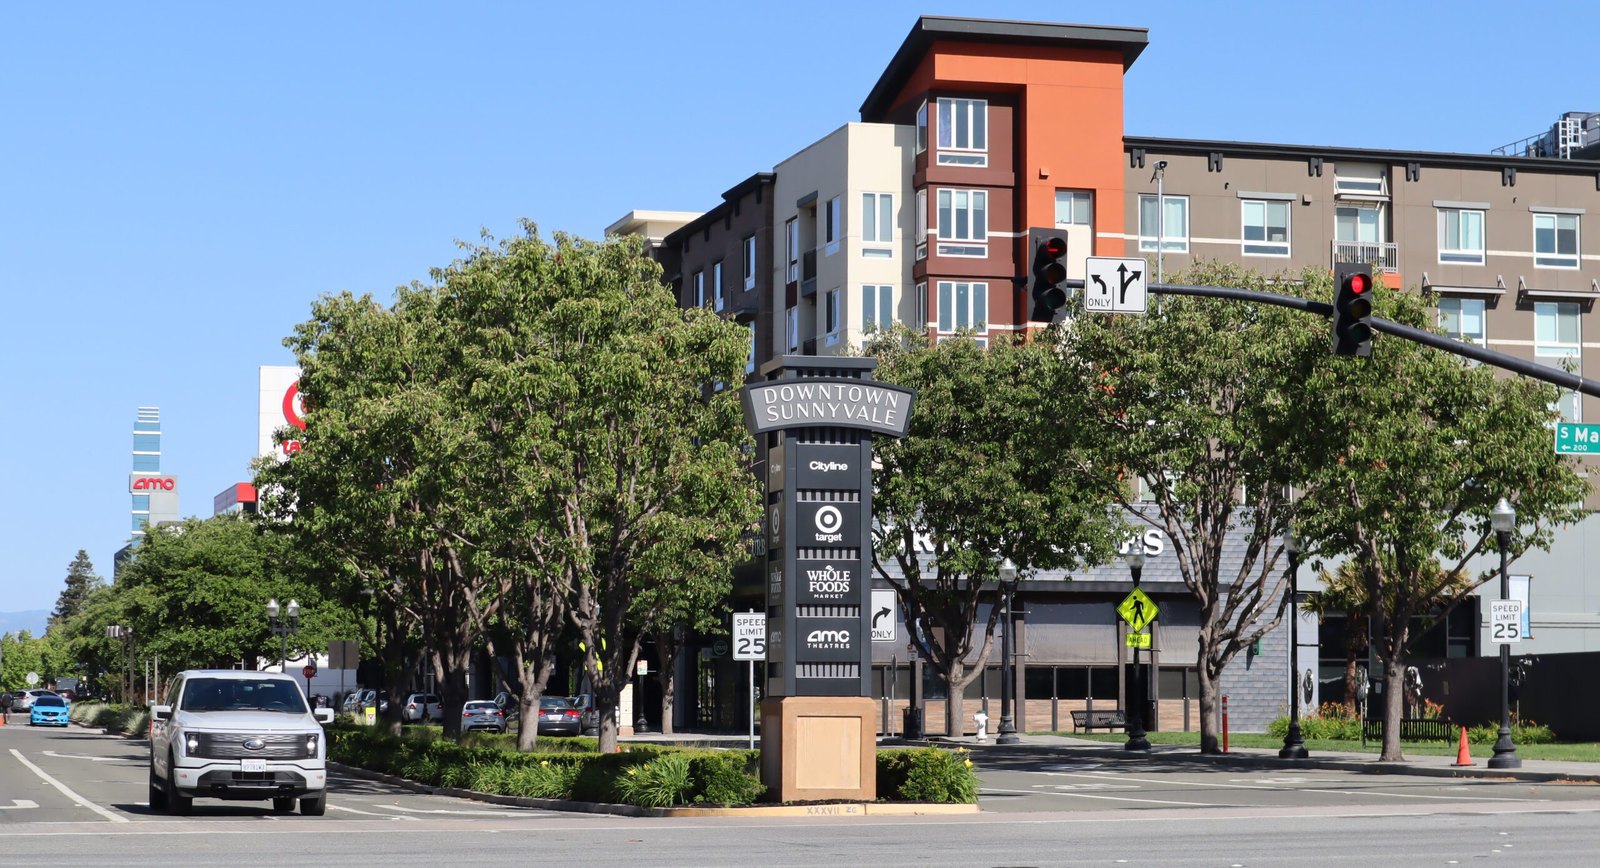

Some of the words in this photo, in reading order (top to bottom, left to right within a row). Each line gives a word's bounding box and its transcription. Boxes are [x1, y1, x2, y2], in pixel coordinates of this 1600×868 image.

[1088, 298, 1111, 307] ONLY
[764, 384, 899, 409] DOWNTOWN
[767, 402, 897, 426] SUNNYVALE
[1560, 426, 1569, 439] S
[809, 461, 848, 472] Cityline
[815, 533, 843, 543] target
[807, 569, 851, 582] WHOLE
[809, 582, 850, 592] FOODS
[736, 619, 766, 627] SPEED
[739, 628, 763, 636] LIMIT
[807, 630, 850, 642] amc
[871, 630, 893, 639] ONLY
[1494, 623, 1518, 639] 25
[737, 638, 766, 655] 25
